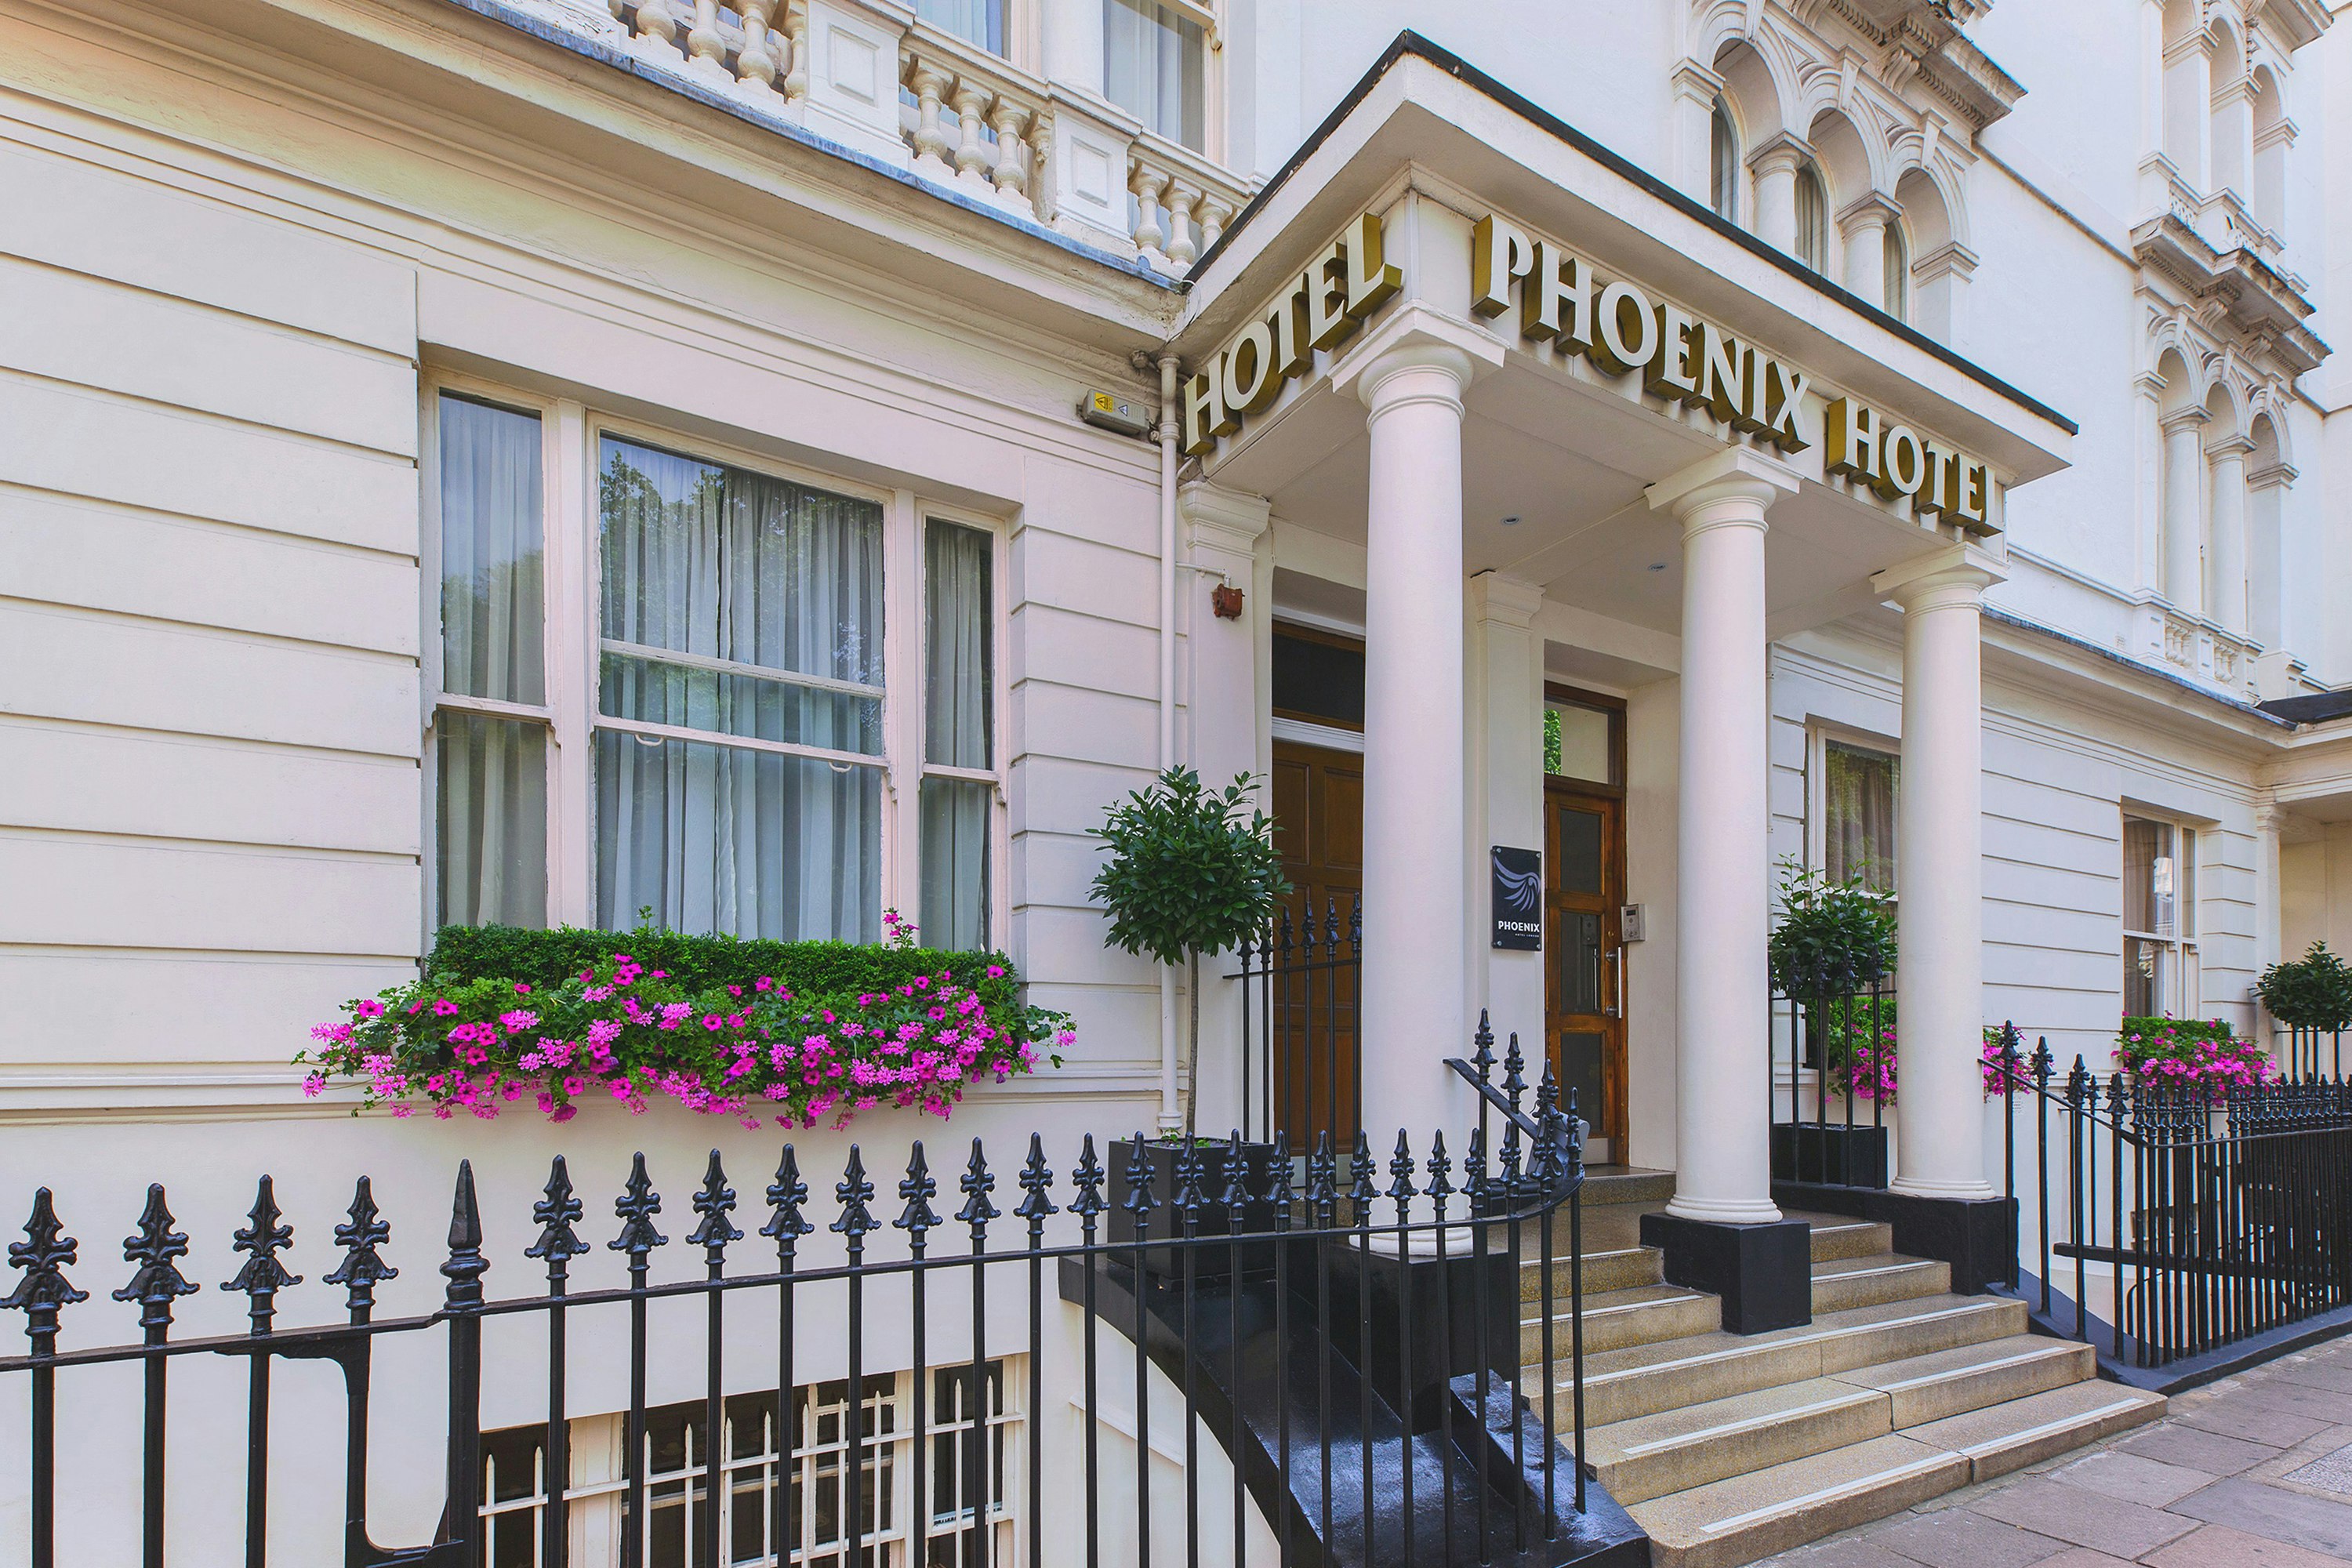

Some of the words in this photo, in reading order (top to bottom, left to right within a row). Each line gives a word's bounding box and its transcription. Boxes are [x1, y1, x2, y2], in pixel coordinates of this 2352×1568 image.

[1184, 212, 1403, 455] HOTEL
[1471, 213, 1811, 454] PHOENIX
[1826, 397, 2003, 537] HOTEL
[1498, 920, 1540, 933] PHOENIX
